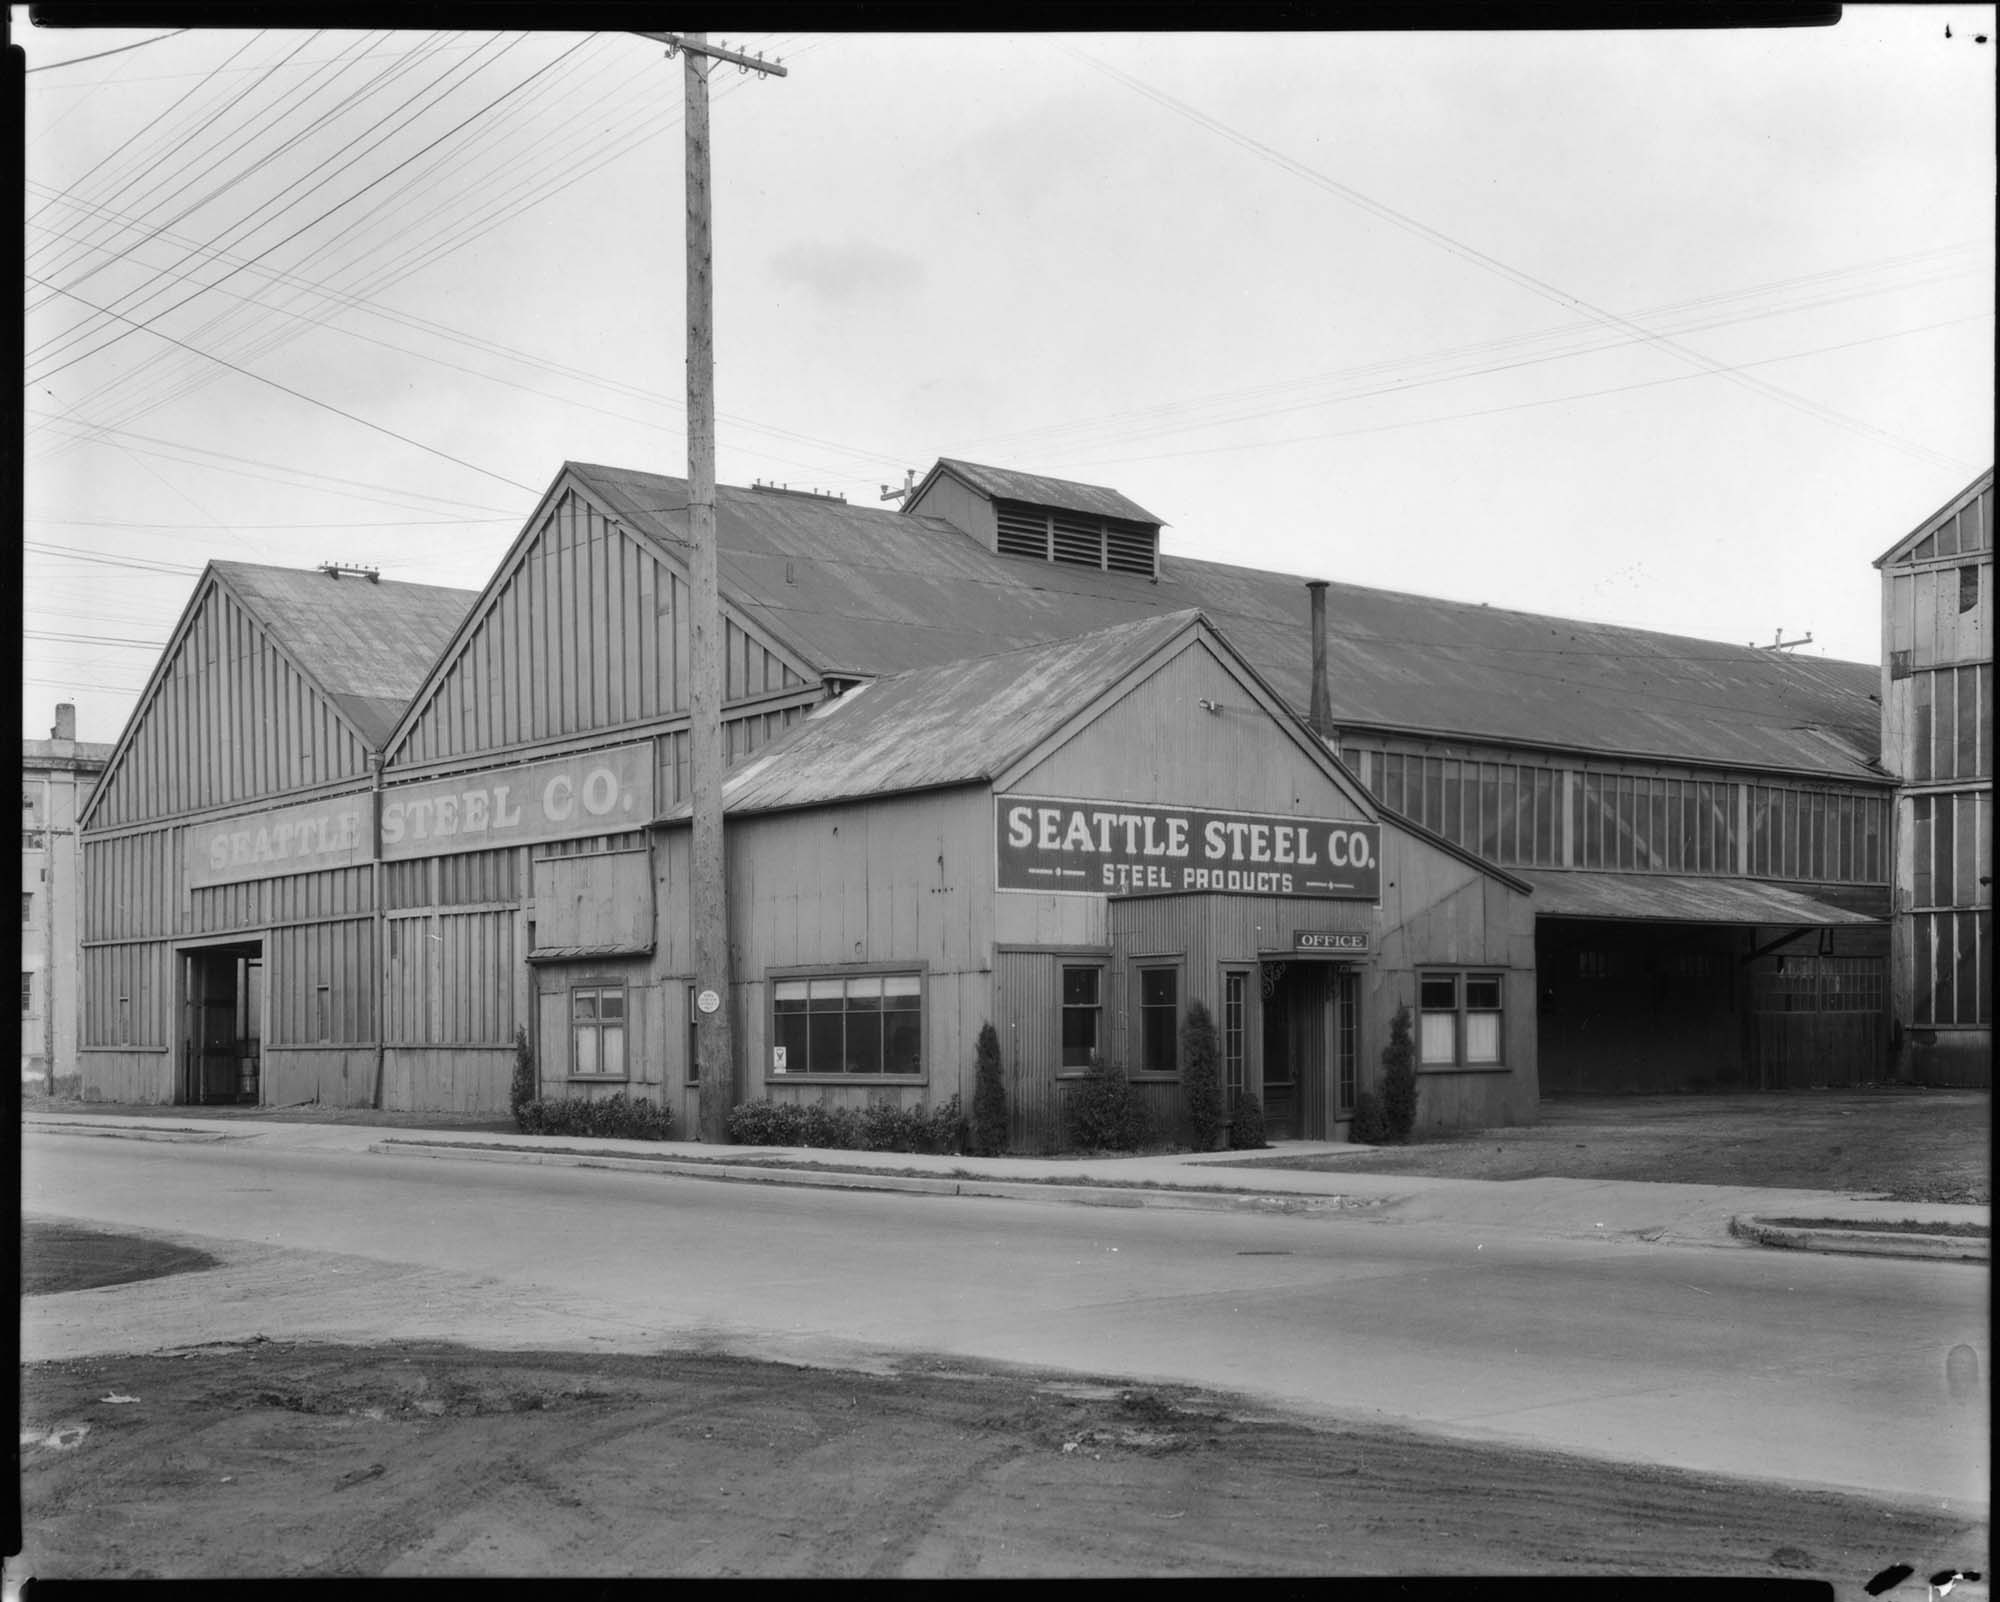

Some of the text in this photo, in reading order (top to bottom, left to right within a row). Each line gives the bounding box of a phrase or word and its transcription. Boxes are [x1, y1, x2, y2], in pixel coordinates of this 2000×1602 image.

[210, 769, 633, 870] SEATTLE STEEL CO.
[1008, 806, 1376, 869] SEATTLE STEEL CO.
[1102, 863, 1293, 892] STEEL PRODUCTS
[1301, 934, 1363, 948] OFFICE
